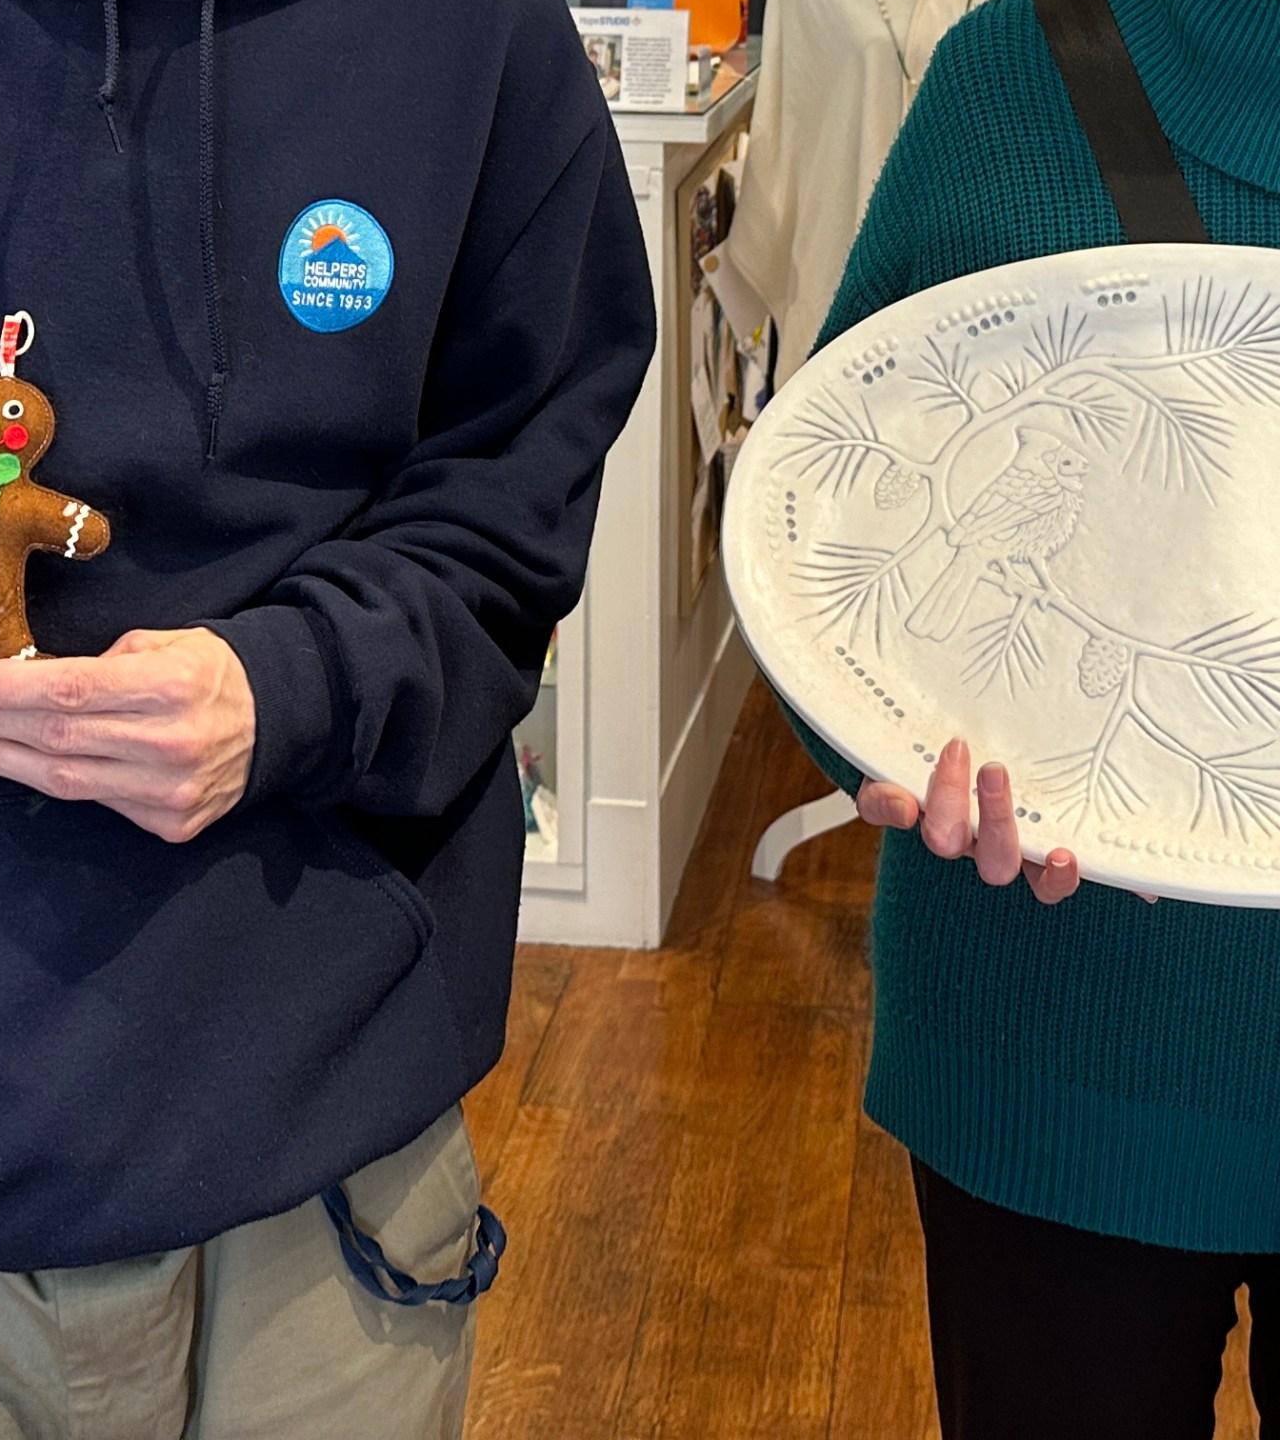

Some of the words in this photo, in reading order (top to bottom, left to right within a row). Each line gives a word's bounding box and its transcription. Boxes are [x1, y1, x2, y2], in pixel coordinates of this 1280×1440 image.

[305, 261, 366, 278] HELPERS
[304, 276, 365, 289] COMMUNITY
[292, 290, 333, 307] SINCE
[340, 294, 372, 309] 1953
